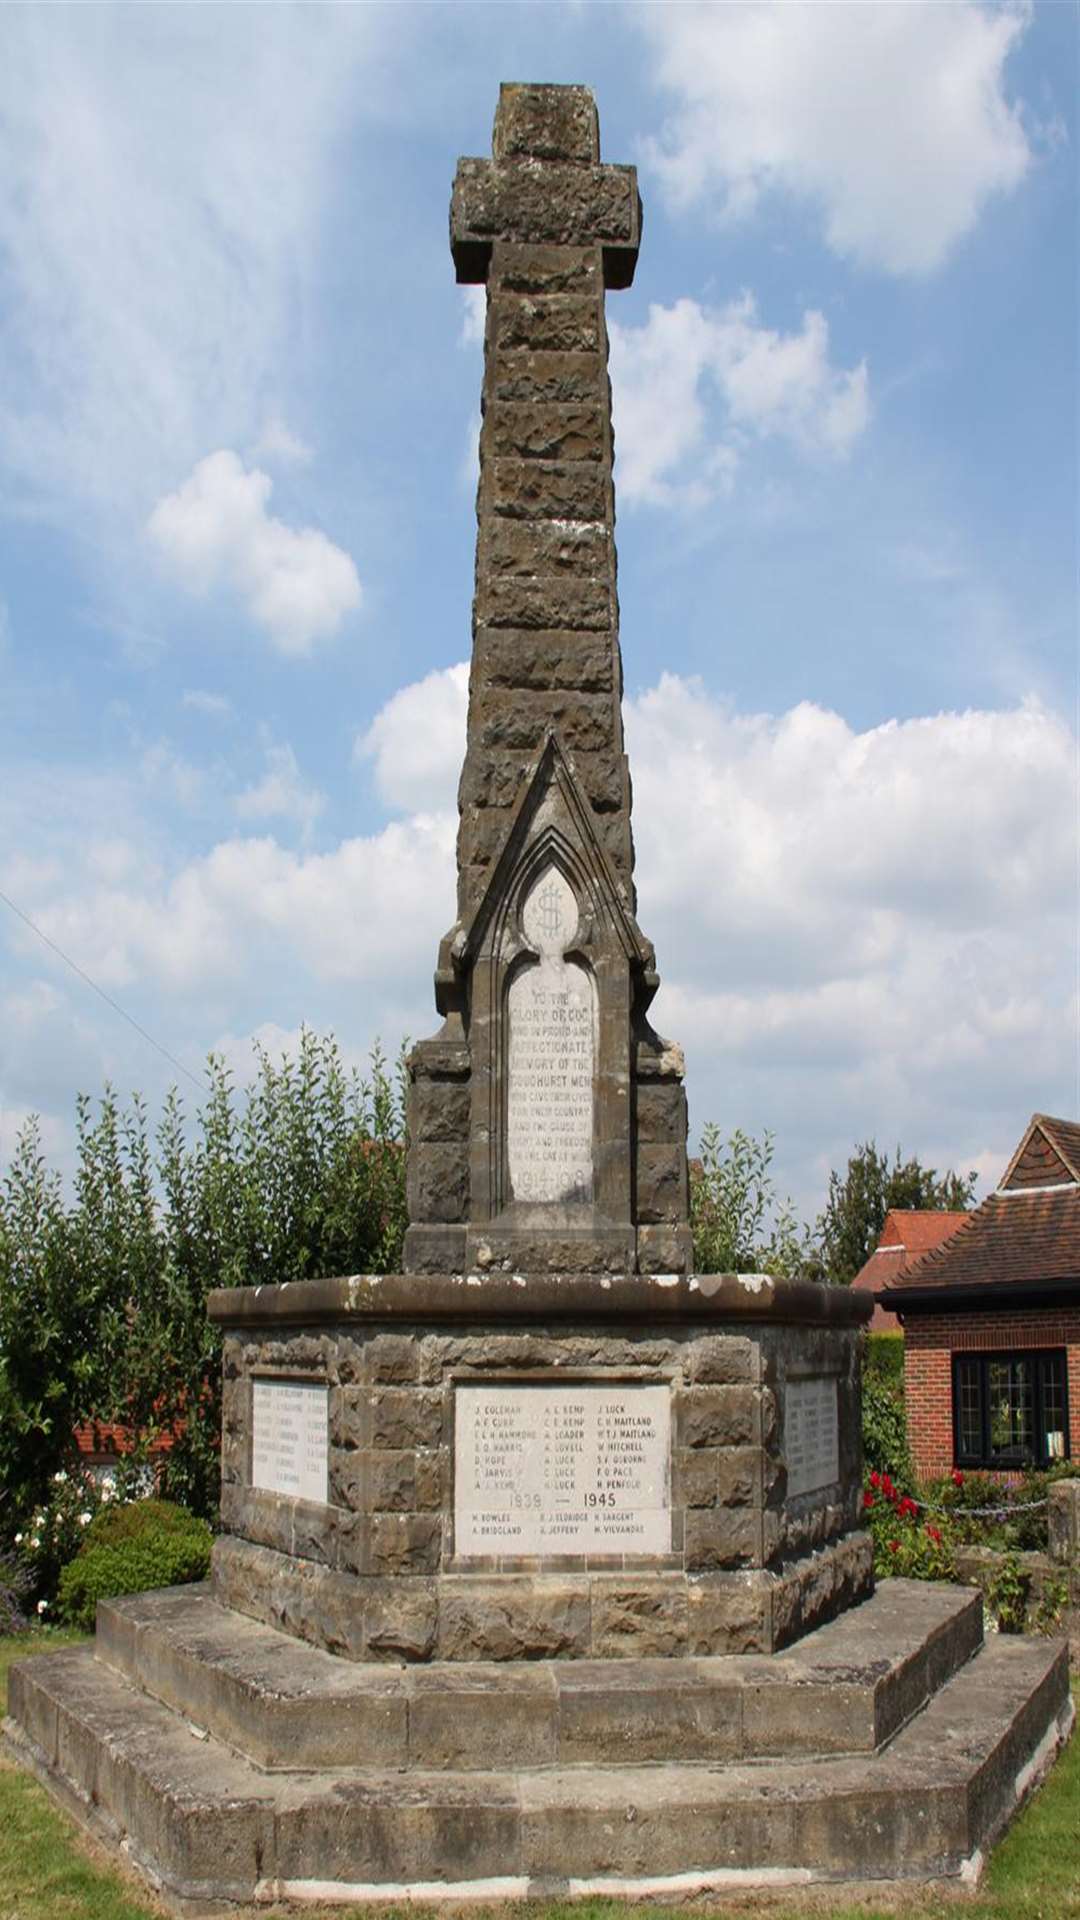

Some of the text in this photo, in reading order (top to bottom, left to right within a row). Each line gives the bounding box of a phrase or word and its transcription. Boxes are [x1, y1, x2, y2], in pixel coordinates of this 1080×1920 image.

[606, 1405, 625, 1415] LUCK
[614, 1416, 652, 1427] MAITLAND
[608, 1442, 643, 1452] MITCHELL
[555, 1455, 575, 1465] LUCK
[555, 1468, 576, 1479] LUCK
[555, 1480, 575, 1491] LUCK
[511, 1494, 543, 1509] 1939
[584, 1492, 617, 1508] 1945
